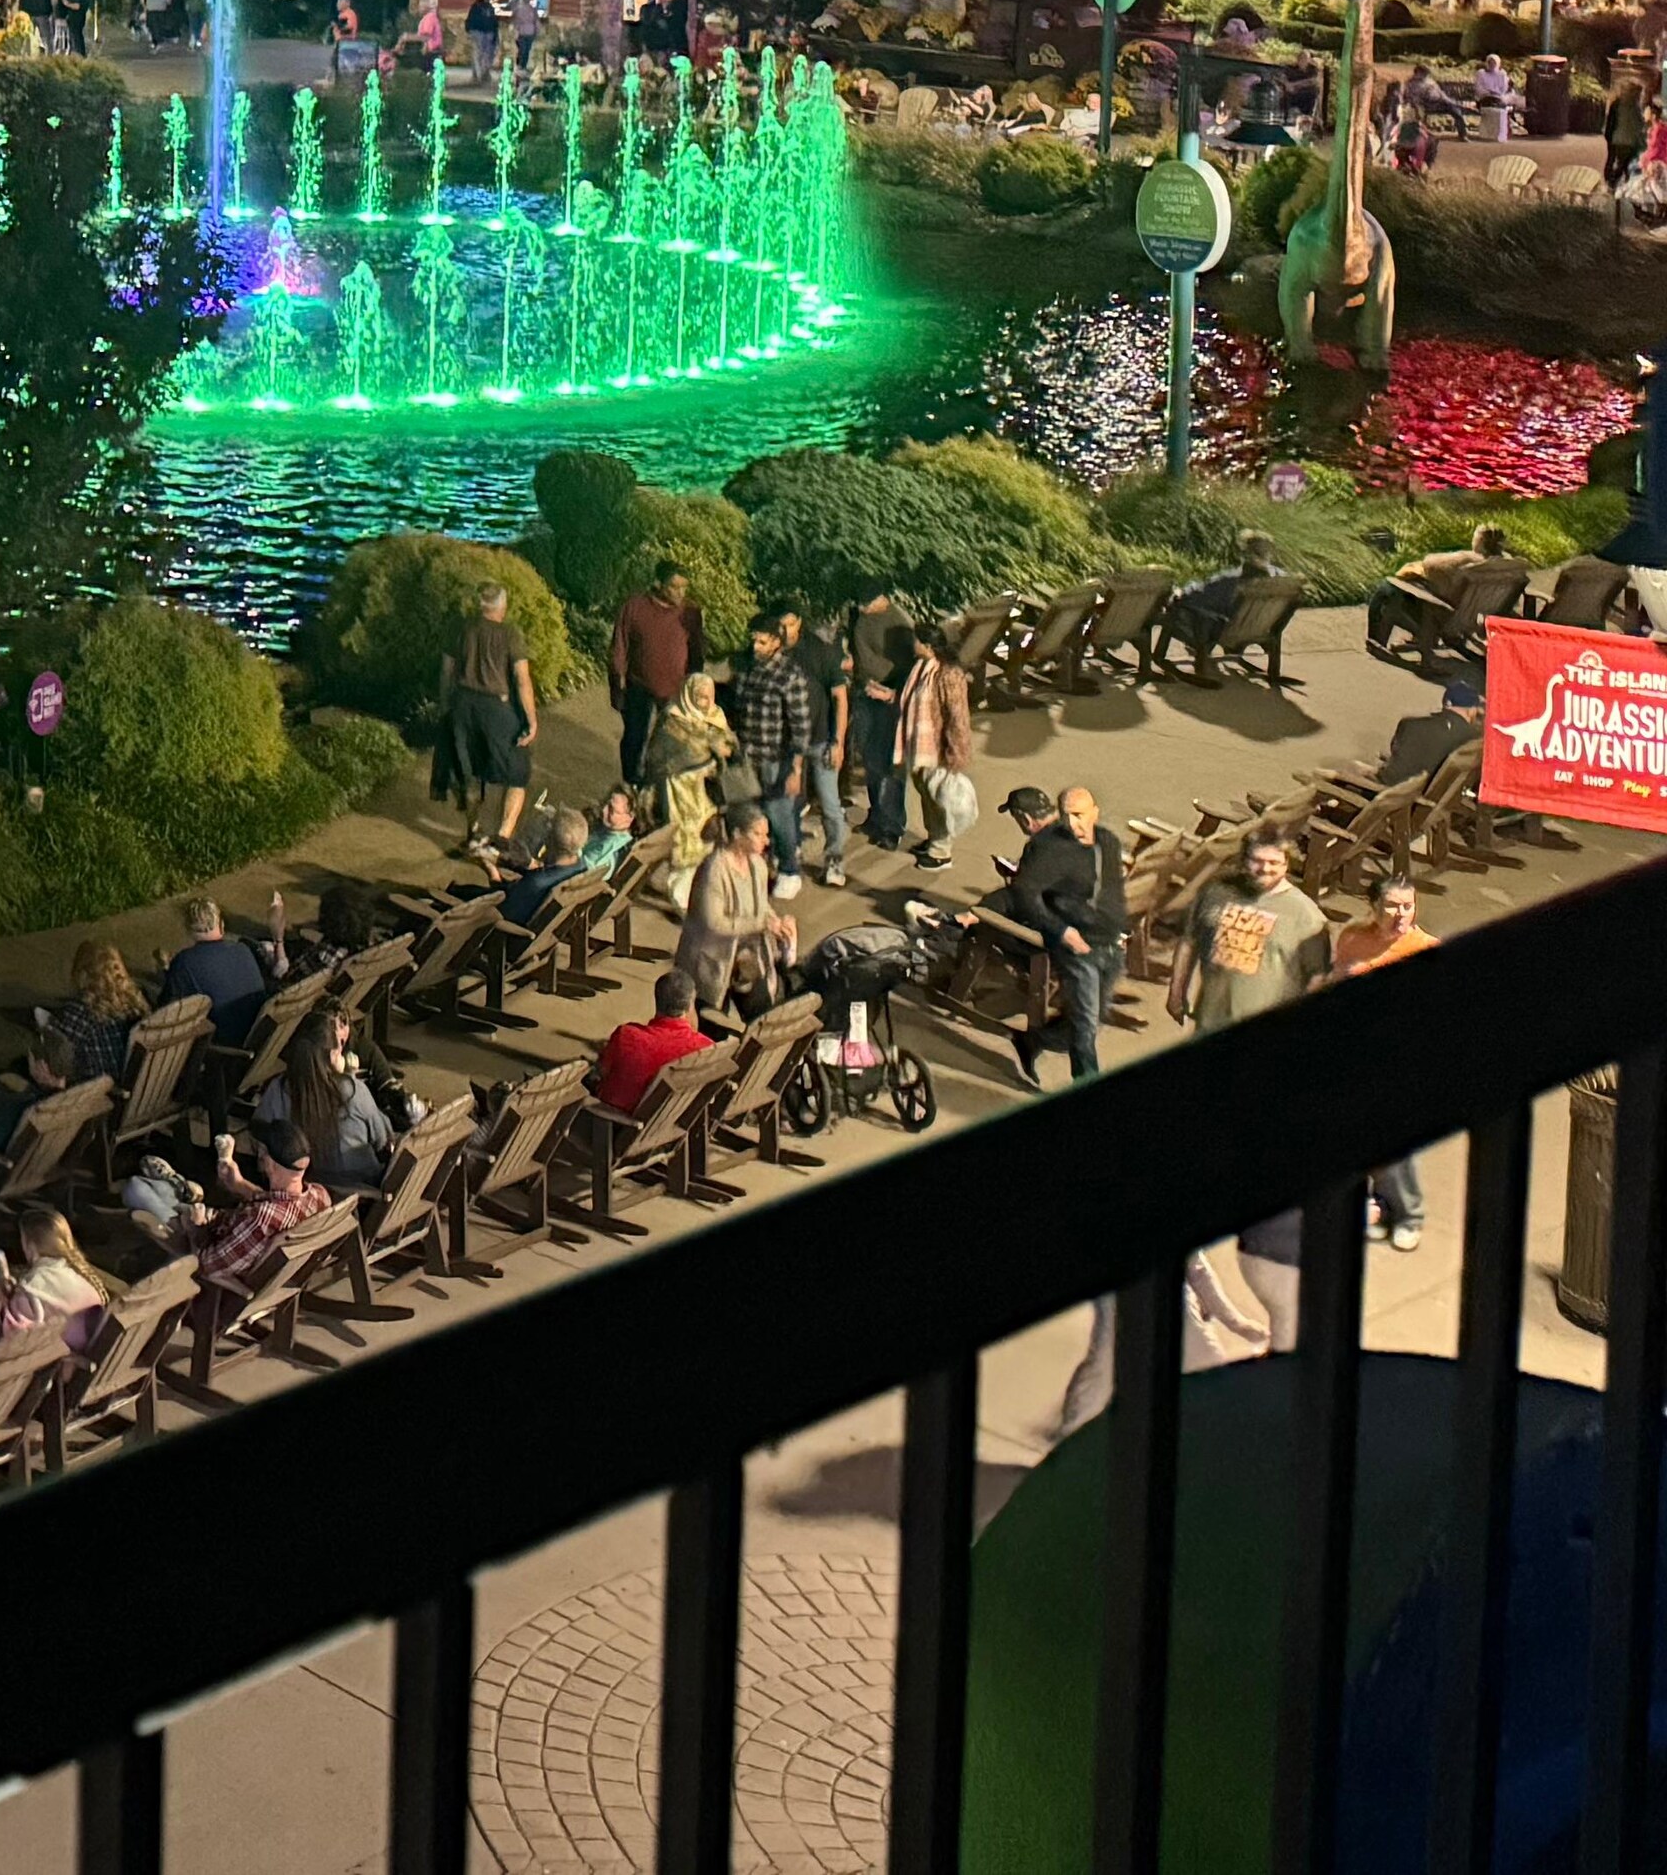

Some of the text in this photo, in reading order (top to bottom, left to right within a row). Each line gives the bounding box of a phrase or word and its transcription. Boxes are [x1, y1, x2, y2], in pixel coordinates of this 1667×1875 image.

[1564, 663, 1603, 686] THE
[1545, 723, 1667, 777] ADVENTU
[1554, 770, 1574, 784] EAT
[1582, 774, 1614, 789] SHOP
[1623, 779, 1652, 798] Play
